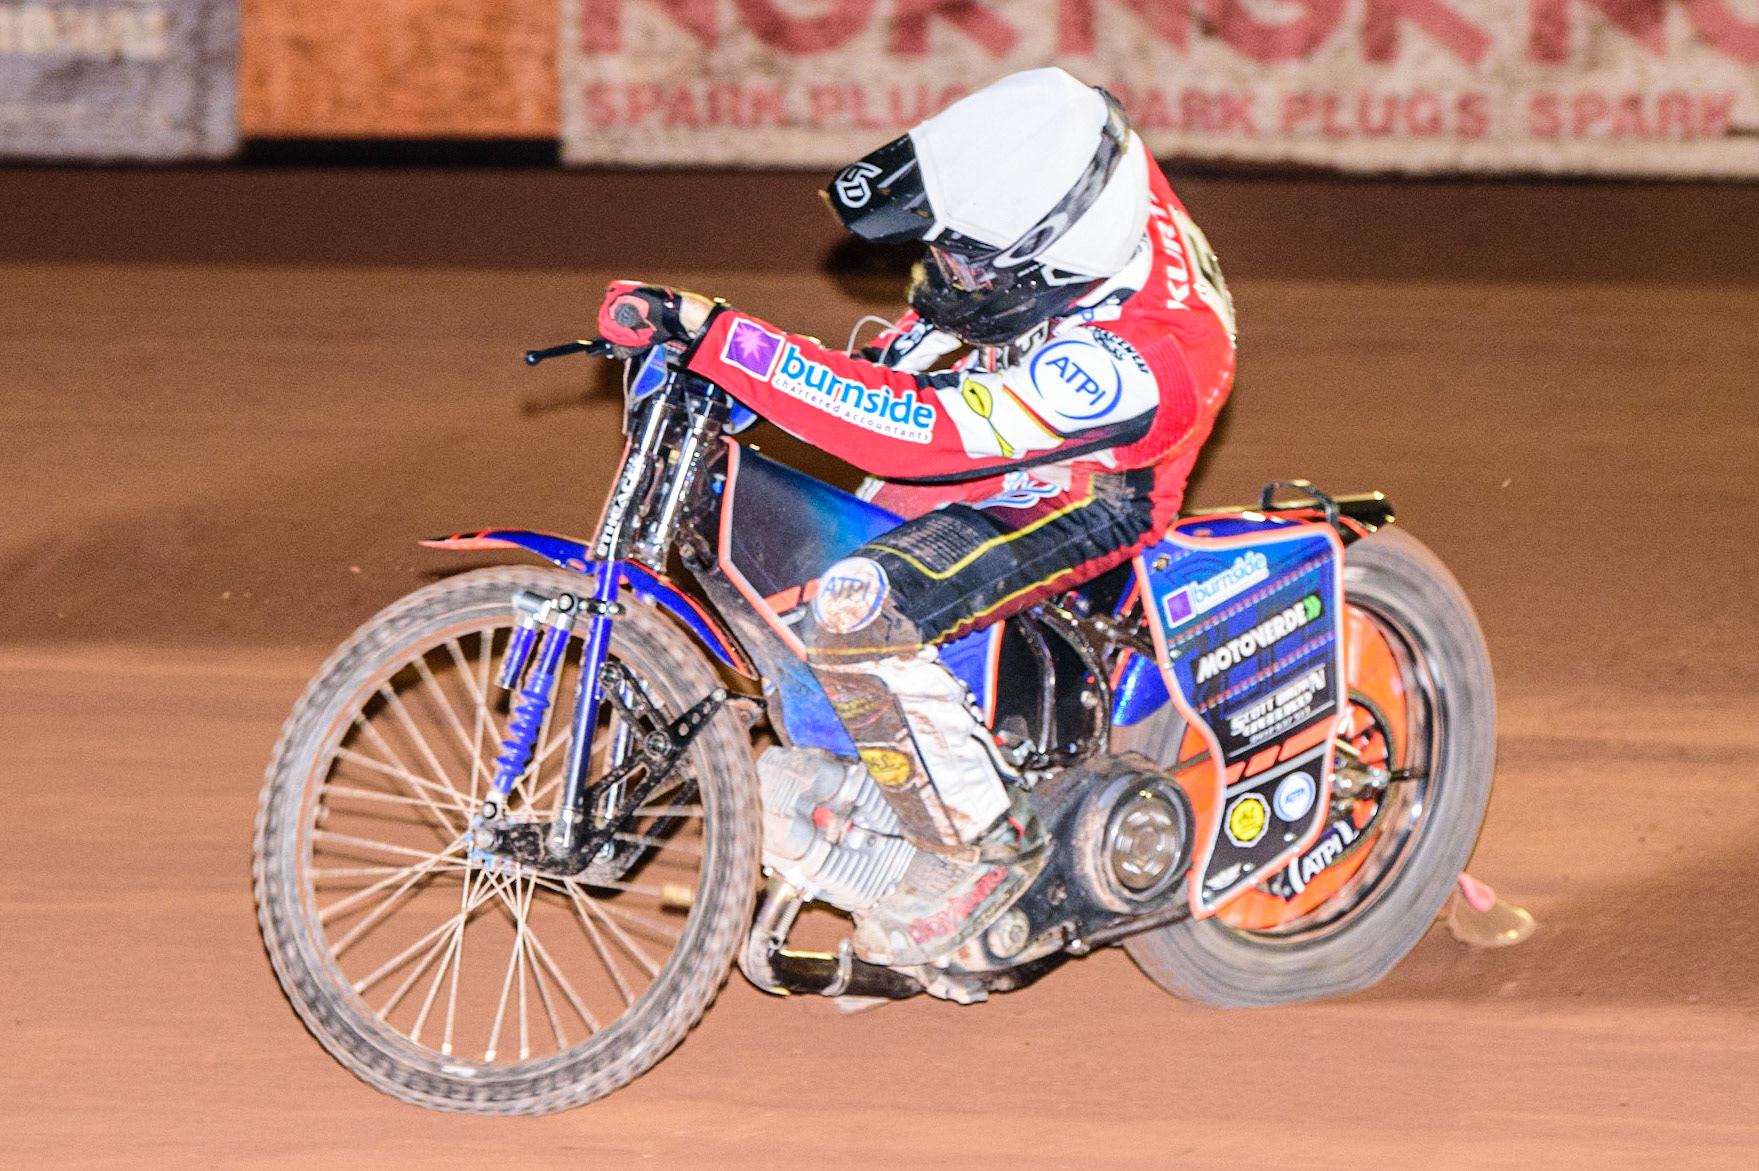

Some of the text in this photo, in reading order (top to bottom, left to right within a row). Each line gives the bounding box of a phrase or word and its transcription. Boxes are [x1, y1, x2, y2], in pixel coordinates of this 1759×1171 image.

[585, 83, 785, 130] SPARK
[1282, 88, 1489, 138] PLUGS
[1529, 91, 1737, 139] SPARK
[779, 345, 933, 429] burnside
[1044, 355, 1107, 406] ATPI
[775, 377, 930, 442] chartered accountants
[821, 575, 872, 601] ATPI
[1196, 602, 1308, 684] MOTOVERDE
[1302, 833, 1344, 884] ATPI
